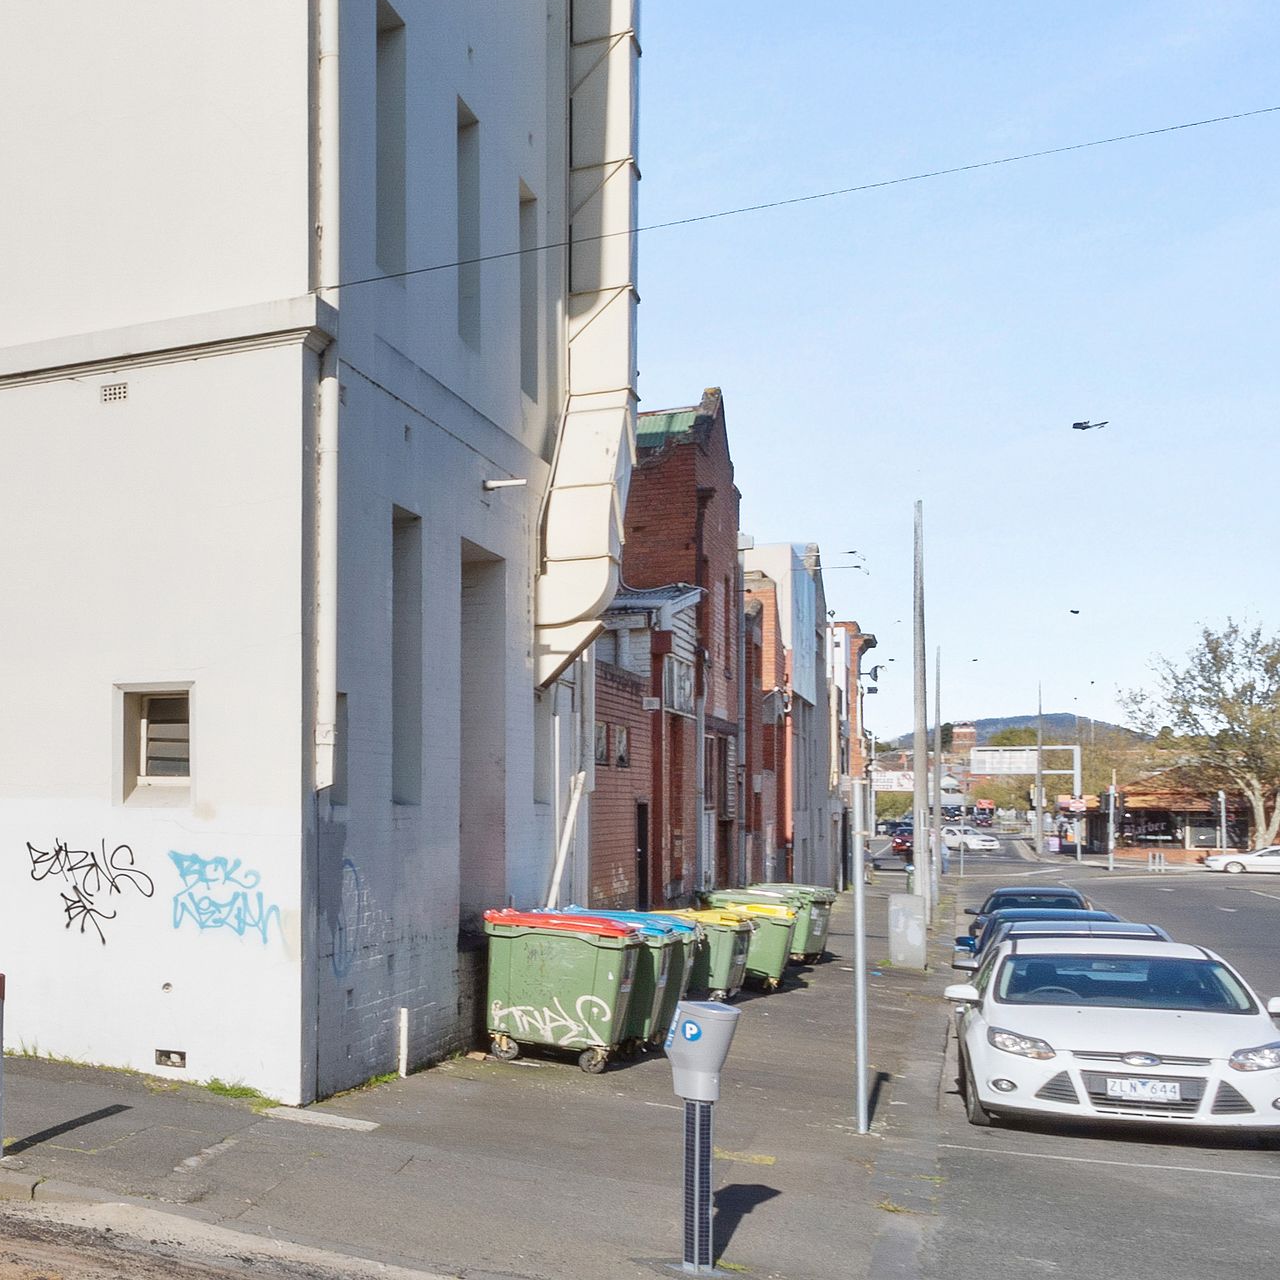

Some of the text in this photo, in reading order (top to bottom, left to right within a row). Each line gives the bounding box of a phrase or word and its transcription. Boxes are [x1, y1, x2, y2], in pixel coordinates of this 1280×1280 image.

[685, 1023, 698, 1039] P
[1109, 1080, 1178, 1096] ZLN 644
